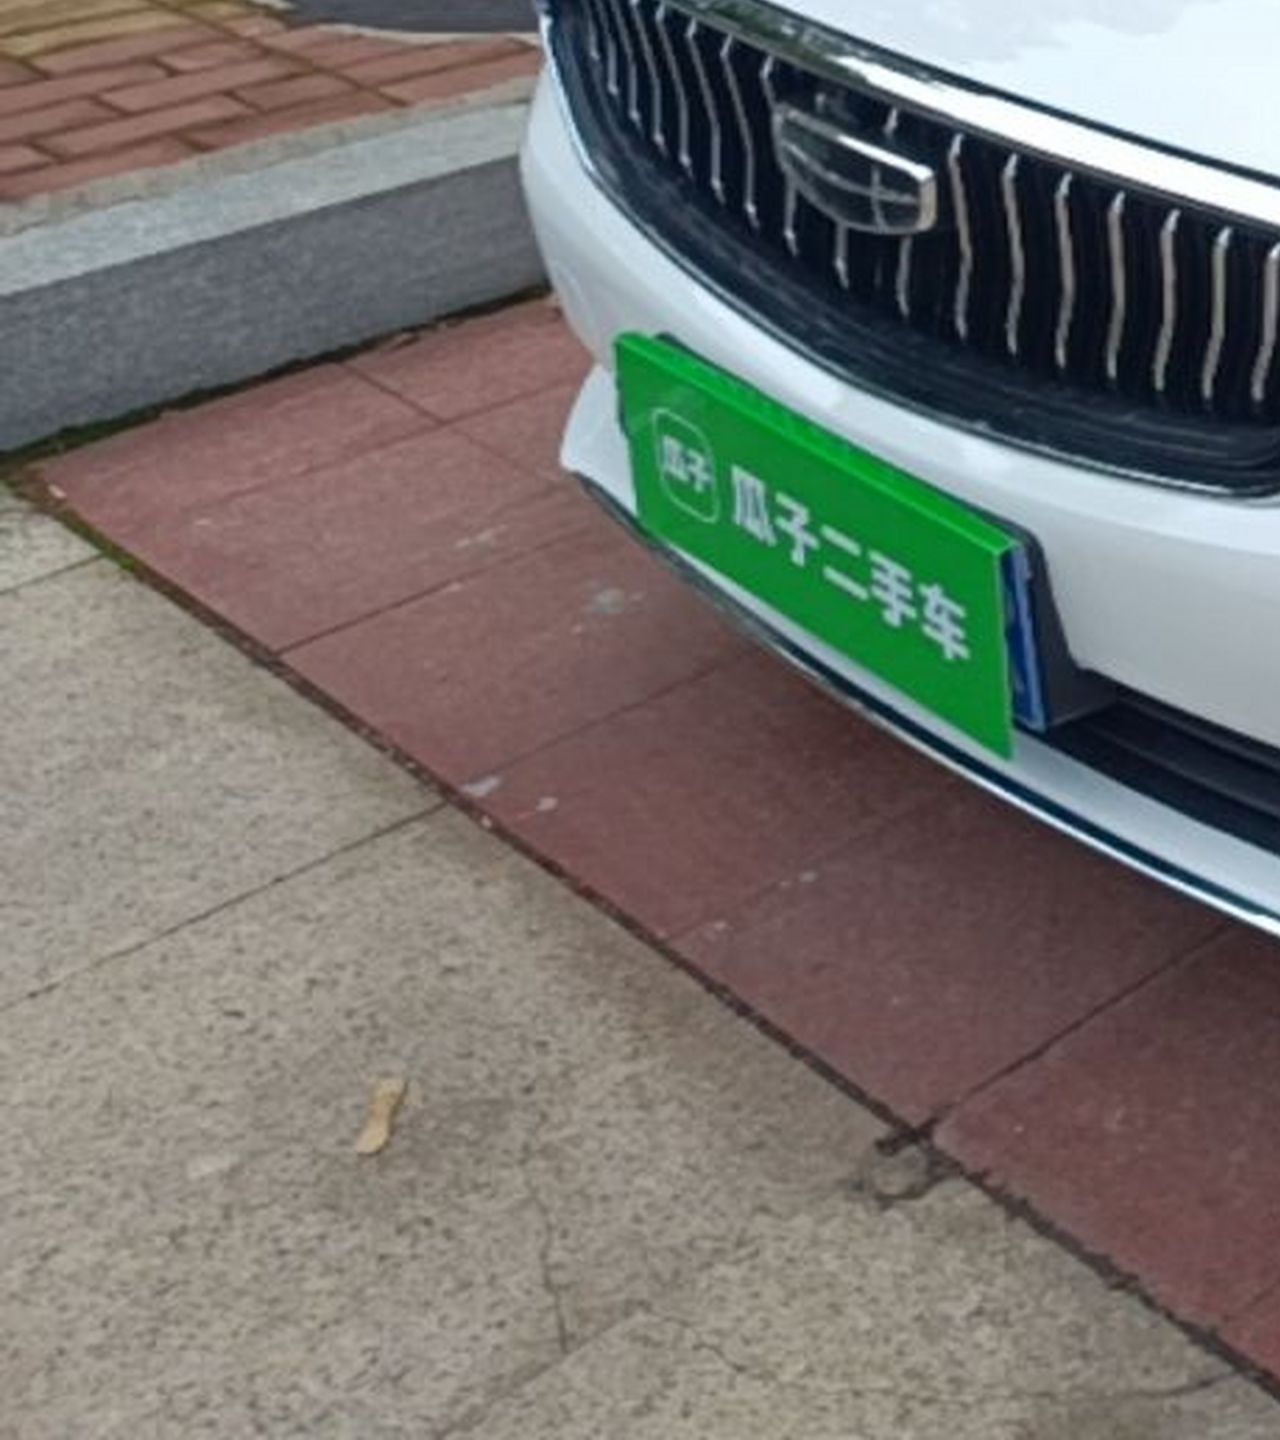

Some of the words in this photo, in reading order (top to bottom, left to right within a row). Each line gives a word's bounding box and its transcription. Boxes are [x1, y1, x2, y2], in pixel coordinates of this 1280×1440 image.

[731, 464, 970, 660] 瓜子二手车
